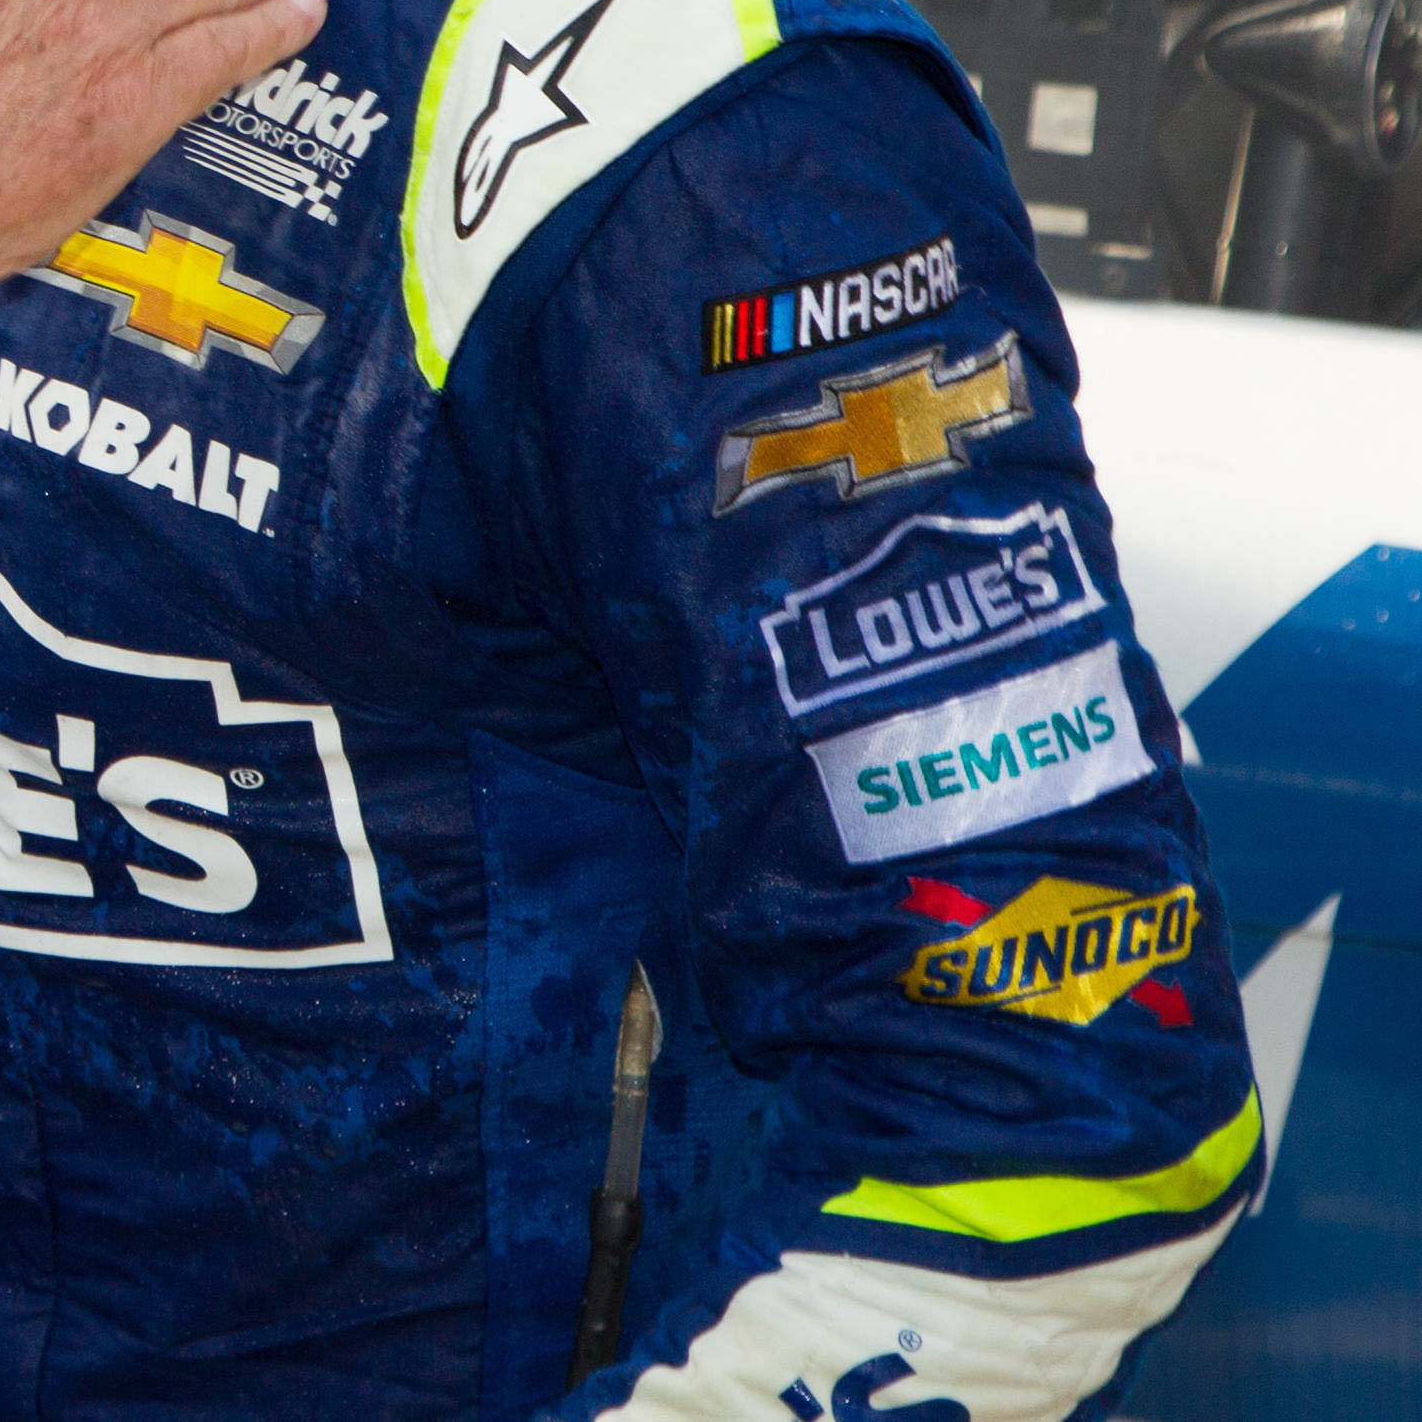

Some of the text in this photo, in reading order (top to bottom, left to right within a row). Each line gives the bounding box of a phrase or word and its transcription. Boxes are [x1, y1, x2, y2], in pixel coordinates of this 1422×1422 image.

[204, 101, 357, 180] OTORSPORTS
[234, 58, 390, 158] drick
[798, 237, 959, 348] NASCAR
[807, 542, 1060, 679] LOWE'S
[856, 695, 1117, 817] SIEMENS
[922, 898, 1190, 999] SUNOCO
